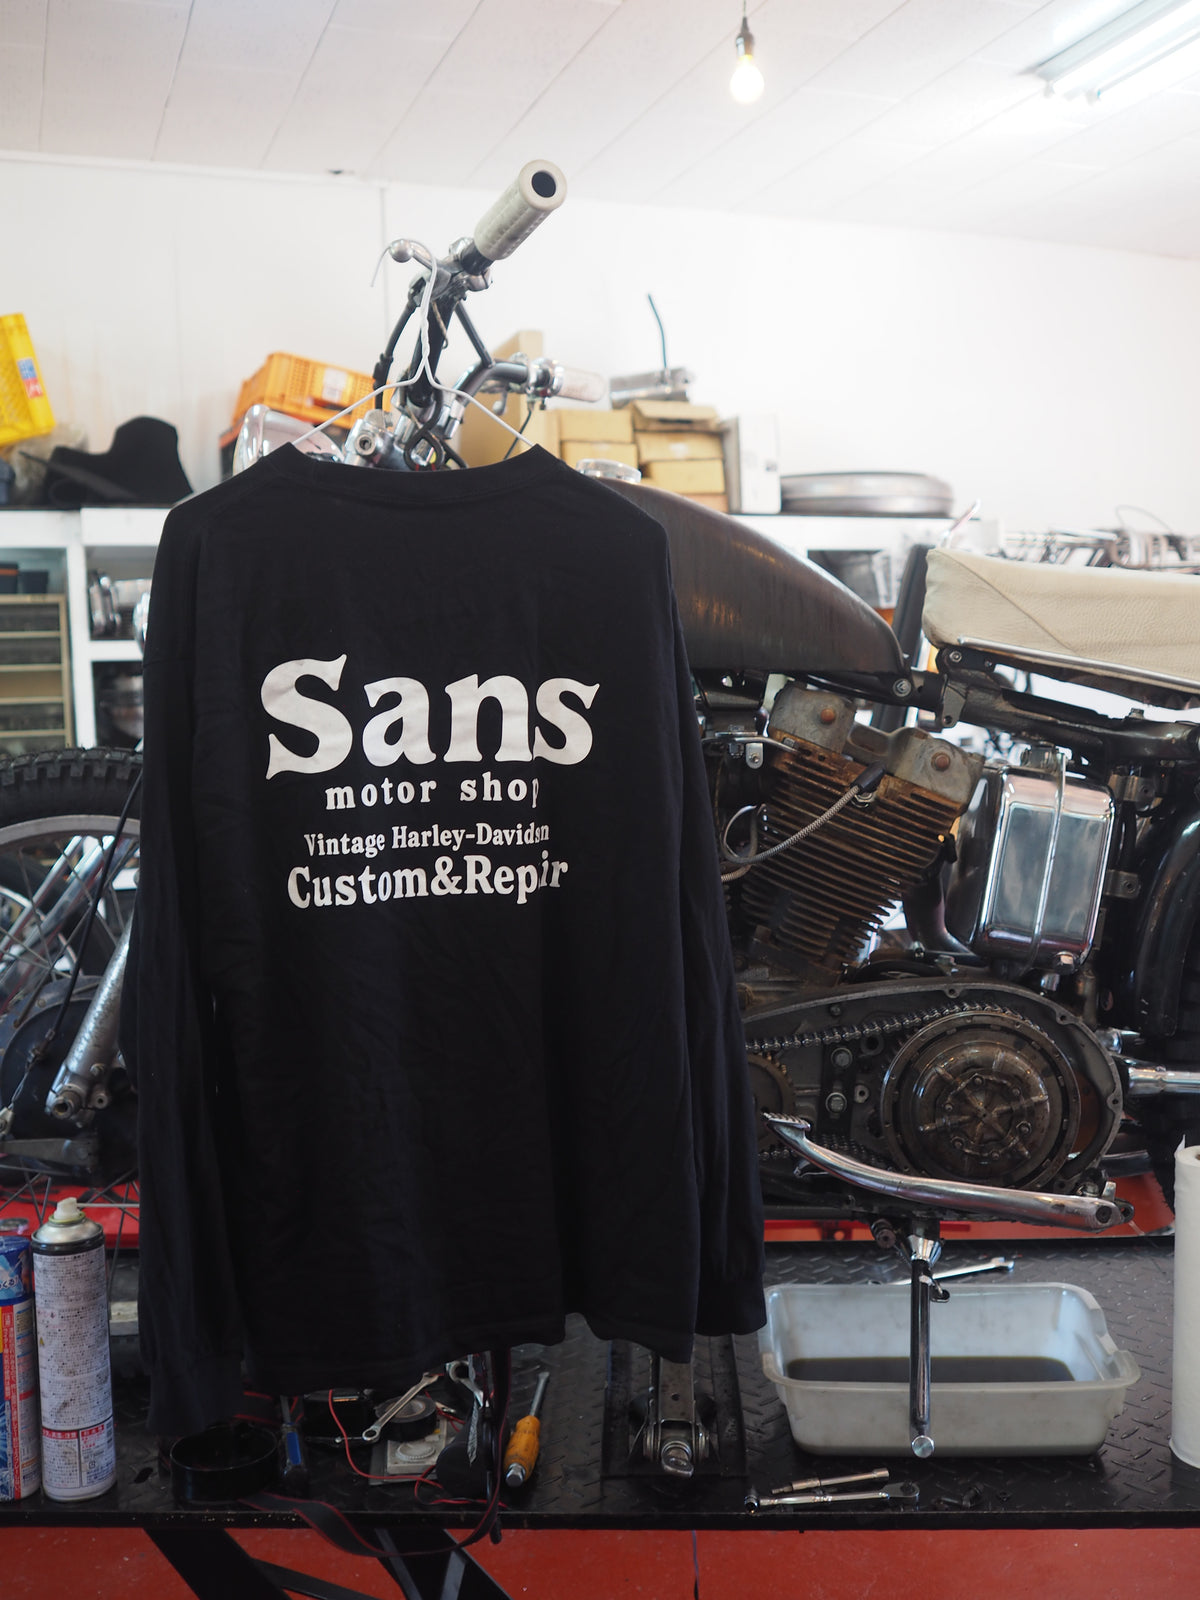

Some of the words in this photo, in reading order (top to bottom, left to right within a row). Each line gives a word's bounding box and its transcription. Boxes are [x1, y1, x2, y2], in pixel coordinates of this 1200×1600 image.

[260, 653, 601, 780] Sans
[324, 777, 437, 811] motor
[303, 832, 386, 859] Vintage
[391, 821, 550, 852] Harley-Davidsn
[287, 849, 569, 909] Custom&Repir
